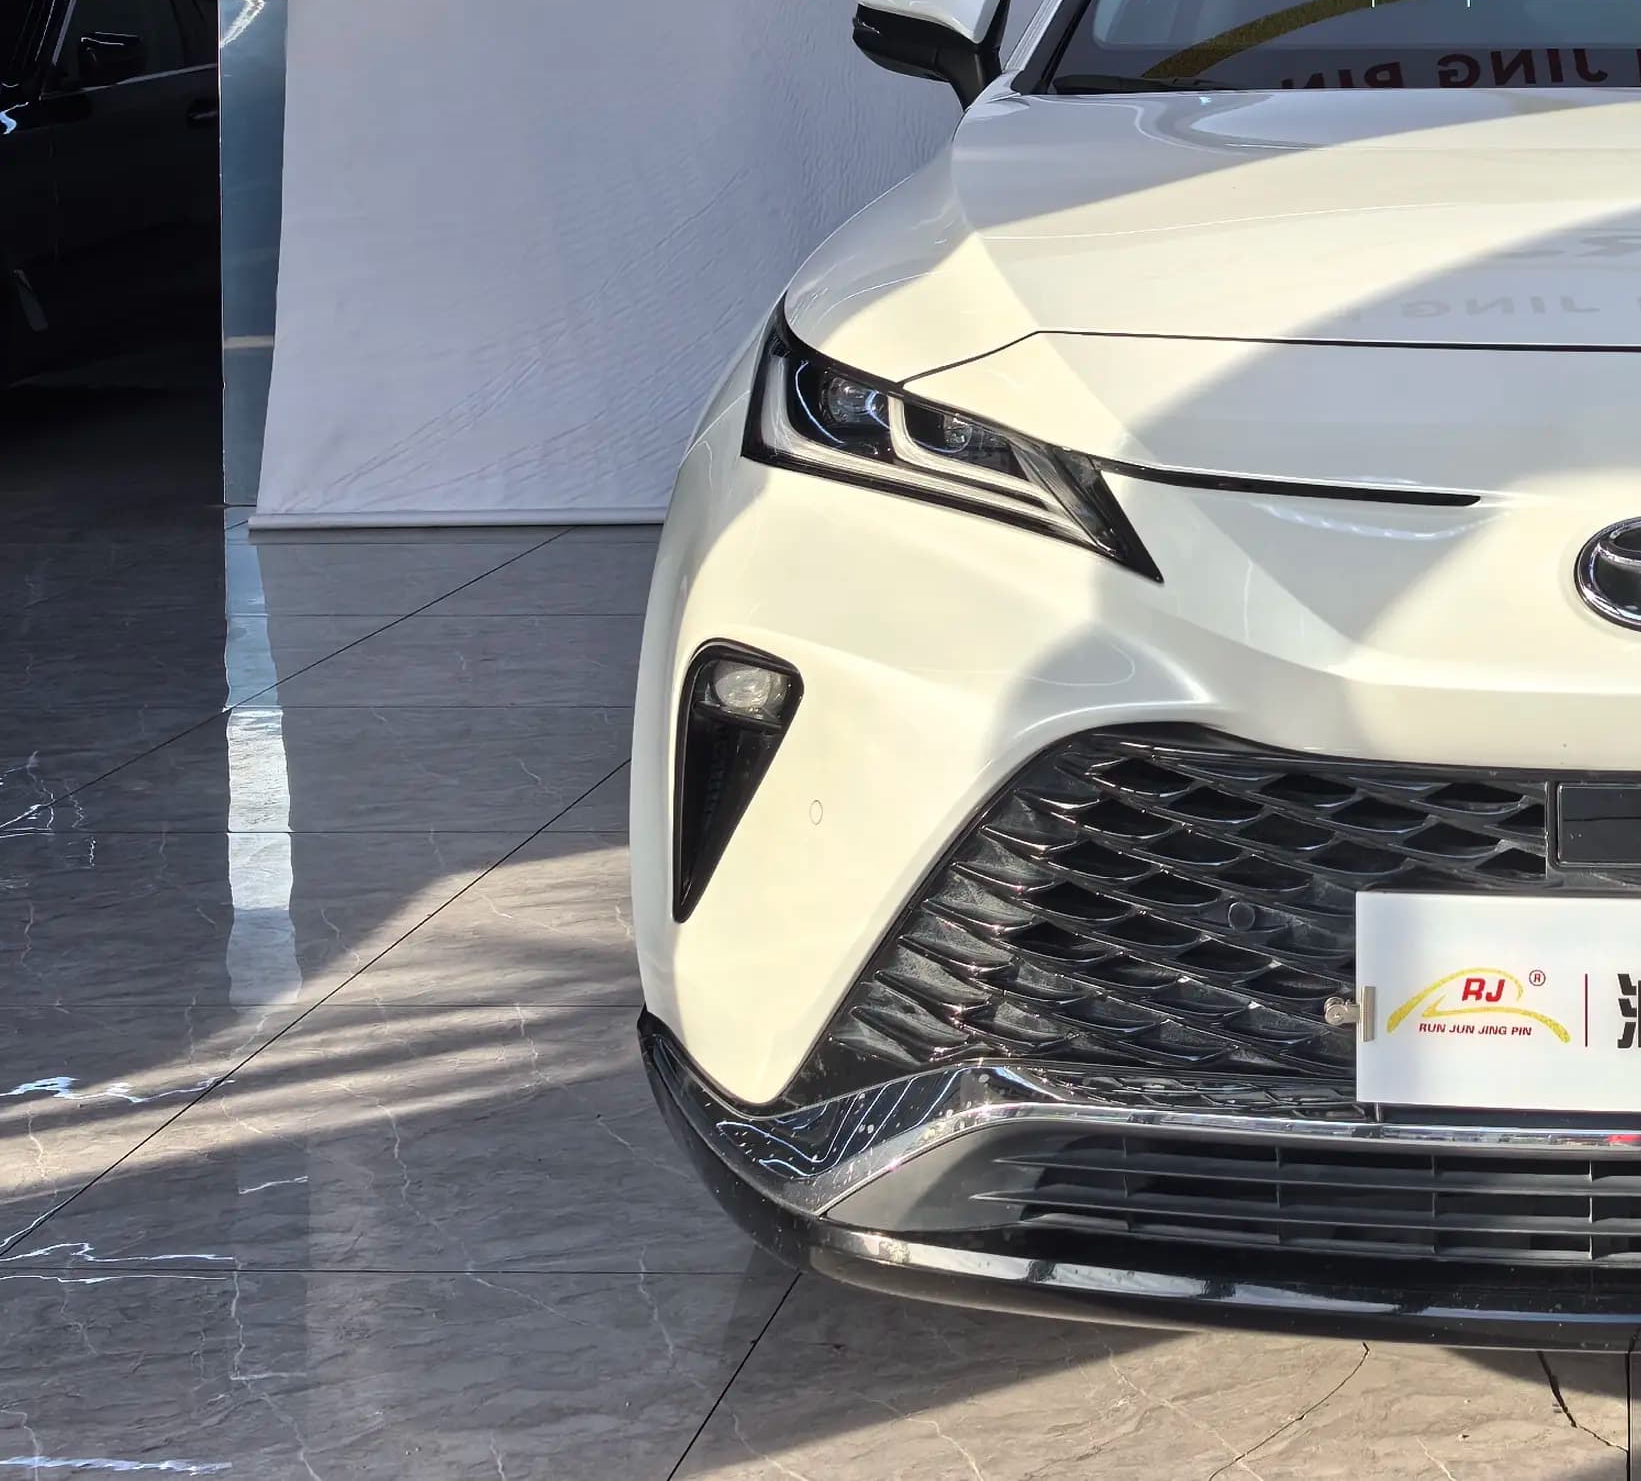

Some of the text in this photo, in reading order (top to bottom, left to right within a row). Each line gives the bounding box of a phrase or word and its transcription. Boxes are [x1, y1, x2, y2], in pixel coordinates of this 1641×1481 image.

[1461, 977, 1506, 1003] RJ
[1418, 1022, 1533, 1037] RUN JUN JING PIN
